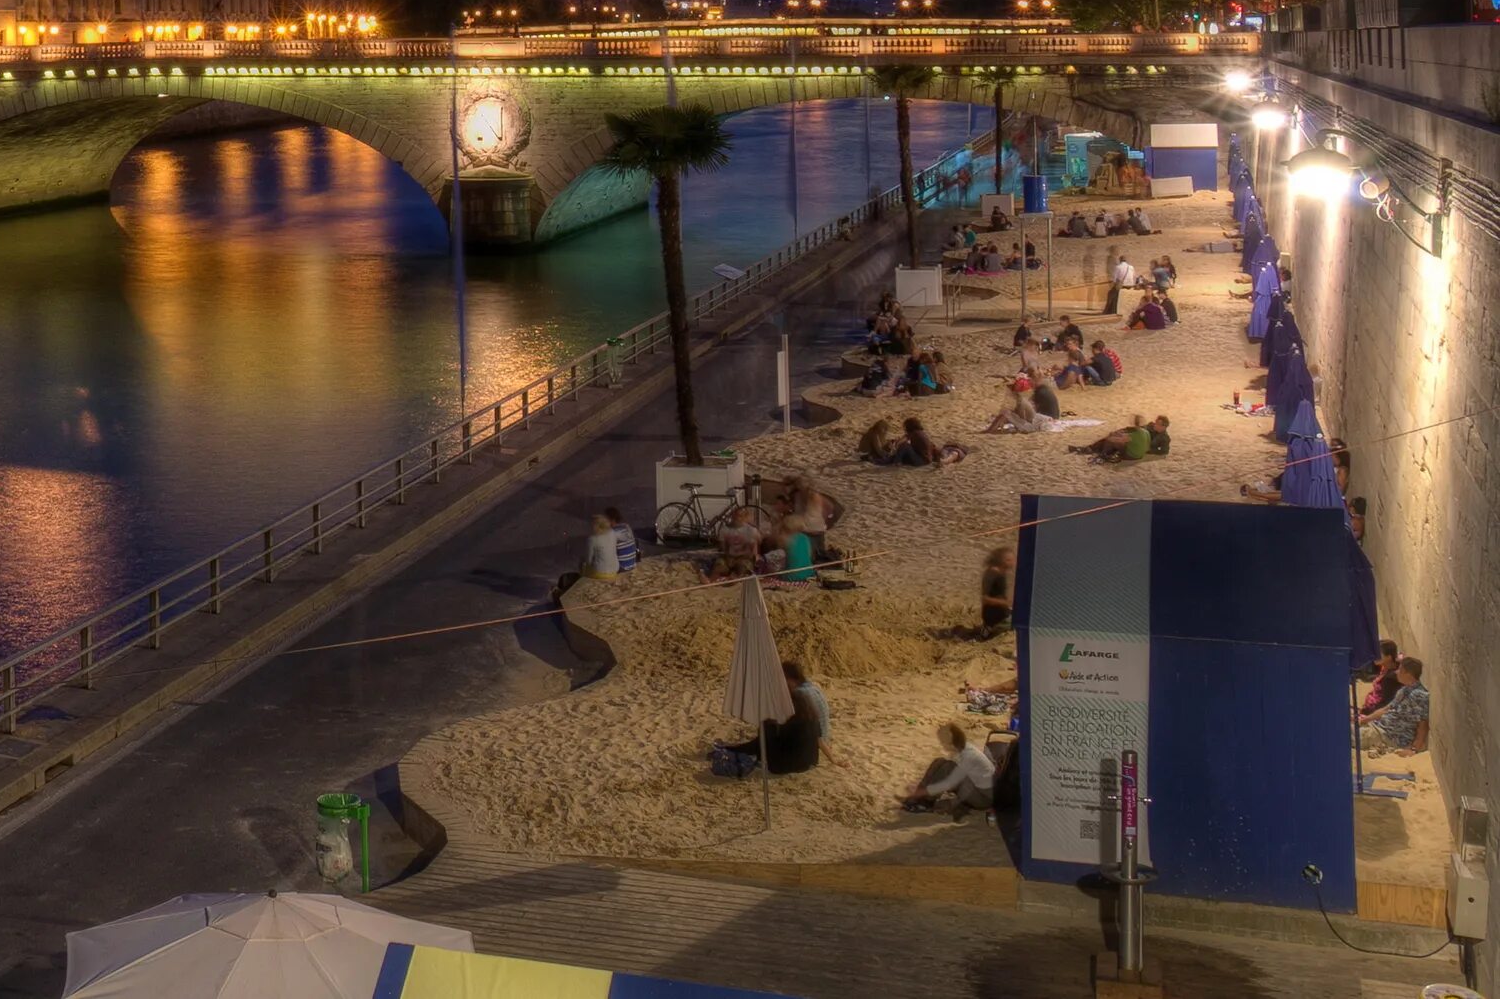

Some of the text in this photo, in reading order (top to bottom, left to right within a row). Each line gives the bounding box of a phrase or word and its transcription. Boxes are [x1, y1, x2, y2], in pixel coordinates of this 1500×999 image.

[1070, 649, 1120, 660] LAFARGE
[1069, 670, 1085, 681] Aide
[1094, 672, 1119, 683] Action
[1048, 705, 1129, 722] BIODIVERSITÉ
[1042, 719, 1138, 736] ET ÉDUCATION
[1043, 733, 1136, 750] EN FRANCE ET
[1041, 746, 1075, 758] DANS
[1077, 750, 1087, 760] LE
